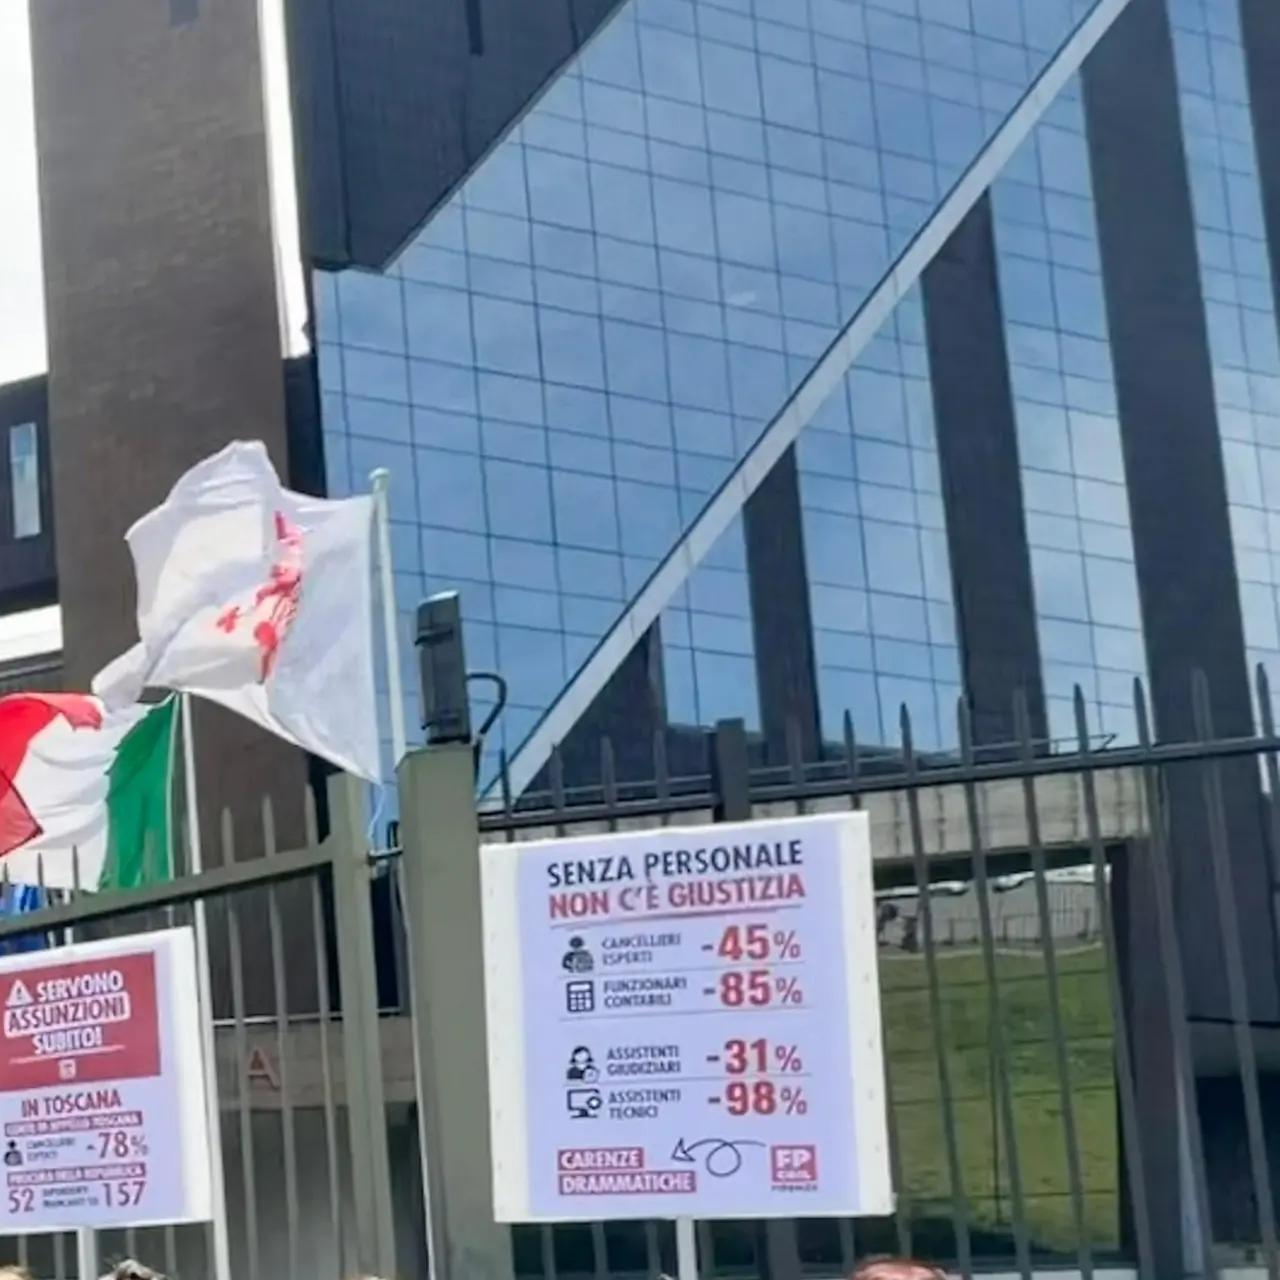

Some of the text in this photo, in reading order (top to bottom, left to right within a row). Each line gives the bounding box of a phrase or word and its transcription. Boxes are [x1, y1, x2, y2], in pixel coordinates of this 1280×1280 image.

[547, 840, 803, 887] SENZA PERSONALE
[549, 890, 610, 919] NON
[668, 873, 806, 908] GIUSTIZIA
[601, 924, 801, 961] CANCELLIERI -45%
[602, 951, 653, 966] ESPERTI
[36, 970, 124, 1002] SERVONO
[603, 994, 672, 1008] CONTABILI
[703, 970, 803, 1007] -85%
[9, 996, 125, 1032] ASSUNZIONI
[32, 1027, 102, 1054] SUBITO!
[606, 1038, 802, 1075] ASSISTENTI -31%
[607, 1061, 681, 1076] GIUDIZIARI
[22, 1089, 122, 1117] IN TOSCANA
[608, 1081, 807, 1116] ASSISTENTI -98%
[609, 1106, 659, 1119] TECNICI
[87, 1131, 148, 1159] -78%
[560, 1150, 812, 1169] CARENZE FP
[8, 1188, 35, 1214] 52
[102, 1180, 146, 1207] 157
[562, 1173, 691, 1193] DRAMMATICHE
